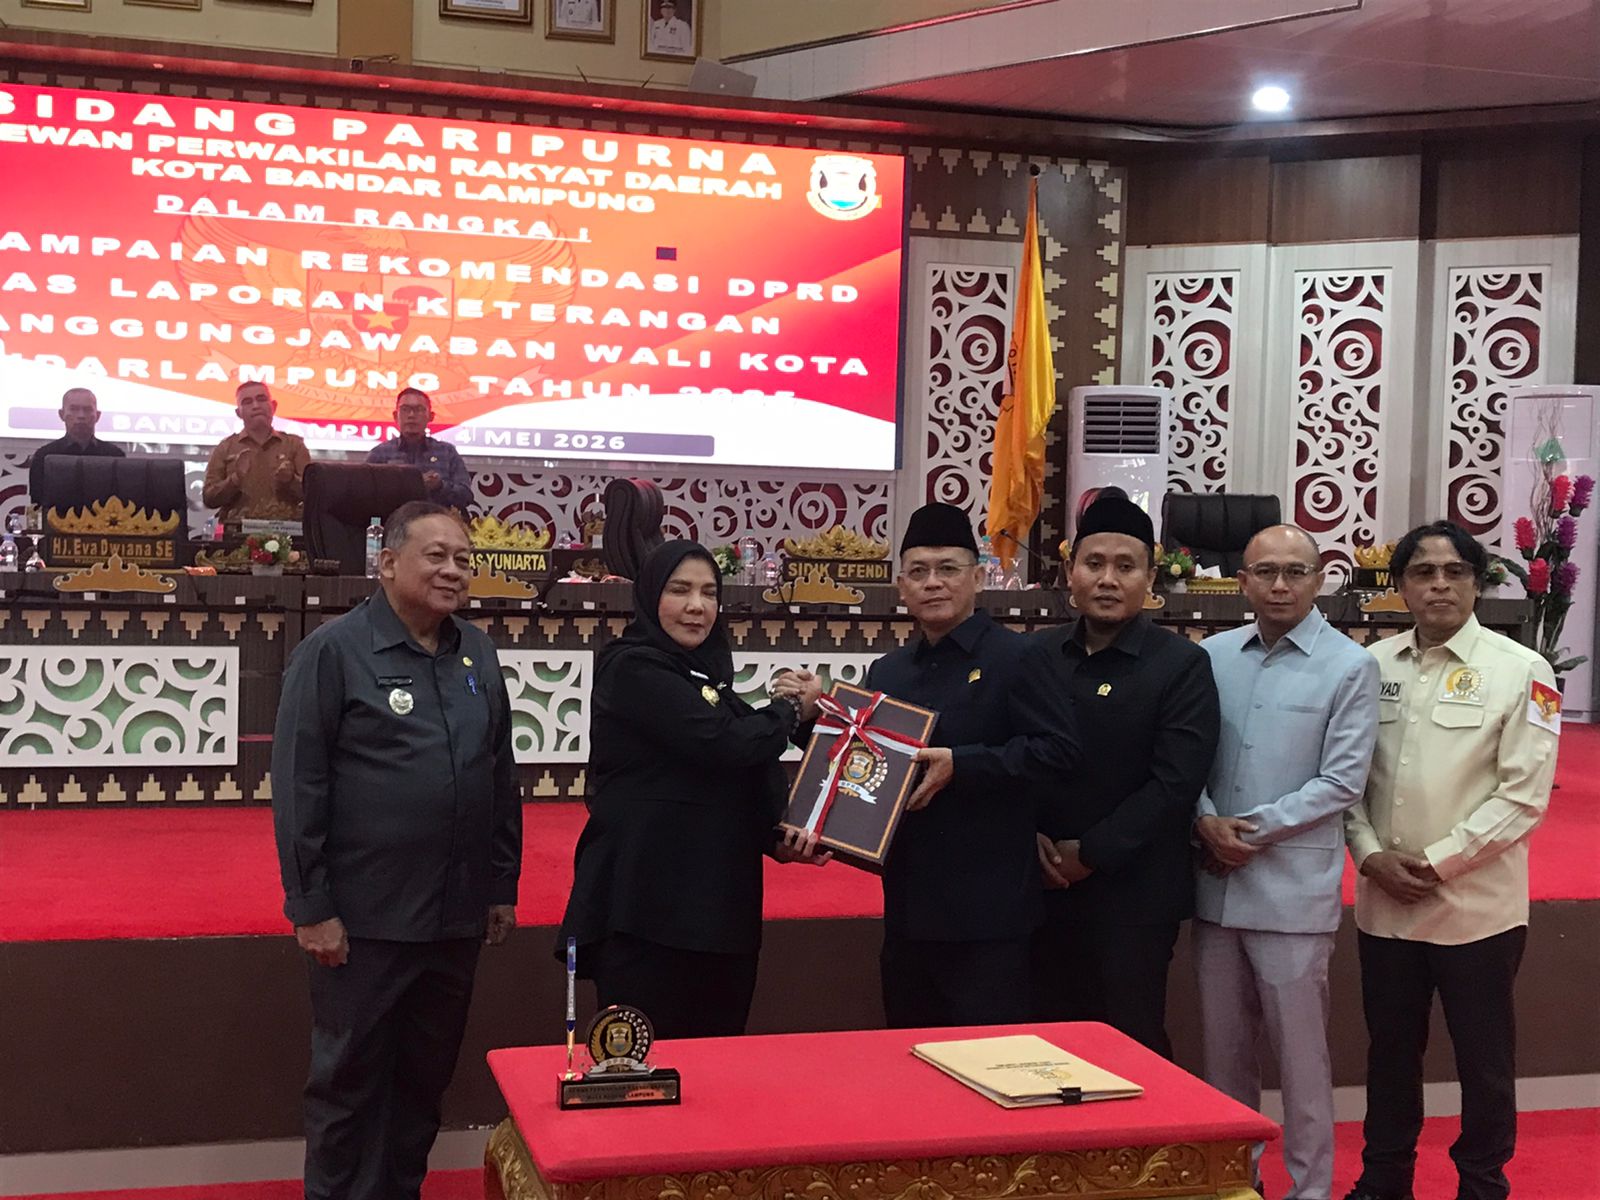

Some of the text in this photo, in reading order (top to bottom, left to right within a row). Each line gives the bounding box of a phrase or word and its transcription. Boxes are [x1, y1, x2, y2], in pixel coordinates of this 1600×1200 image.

[333, 118, 776, 175] PARIPURNA
[132, 158, 655, 213] KOTA BANDAR LAMPUNG
[148, 134, 436, 173] PERWAKILAN
[450, 158, 613, 186] RAKYAT
[625, 171, 782, 200] DAERAH
[156, 194, 326, 222] DALAM
[354, 208, 553, 240] RANGKA
[301, 250, 699, 294] REKOMENDASI
[728, 278, 858, 303] DPRD
[2, 272, 779, 335] AS LAPORAN KETERANGAN
[583, 344, 711, 368] WALI
[740, 353, 868, 376] KOTA
[470, 375, 650, 400] TAHUN
[485, 430, 542, 447] MEI
[553, 433, 625, 450] 2026
[74, 538, 98, 555] Eva
[101, 539, 152, 557] Dwiana
[156, 540, 173, 557] SE
[486, 553, 546, 570] YUNIARTA
[838, 563, 888, 579] EFENDI
